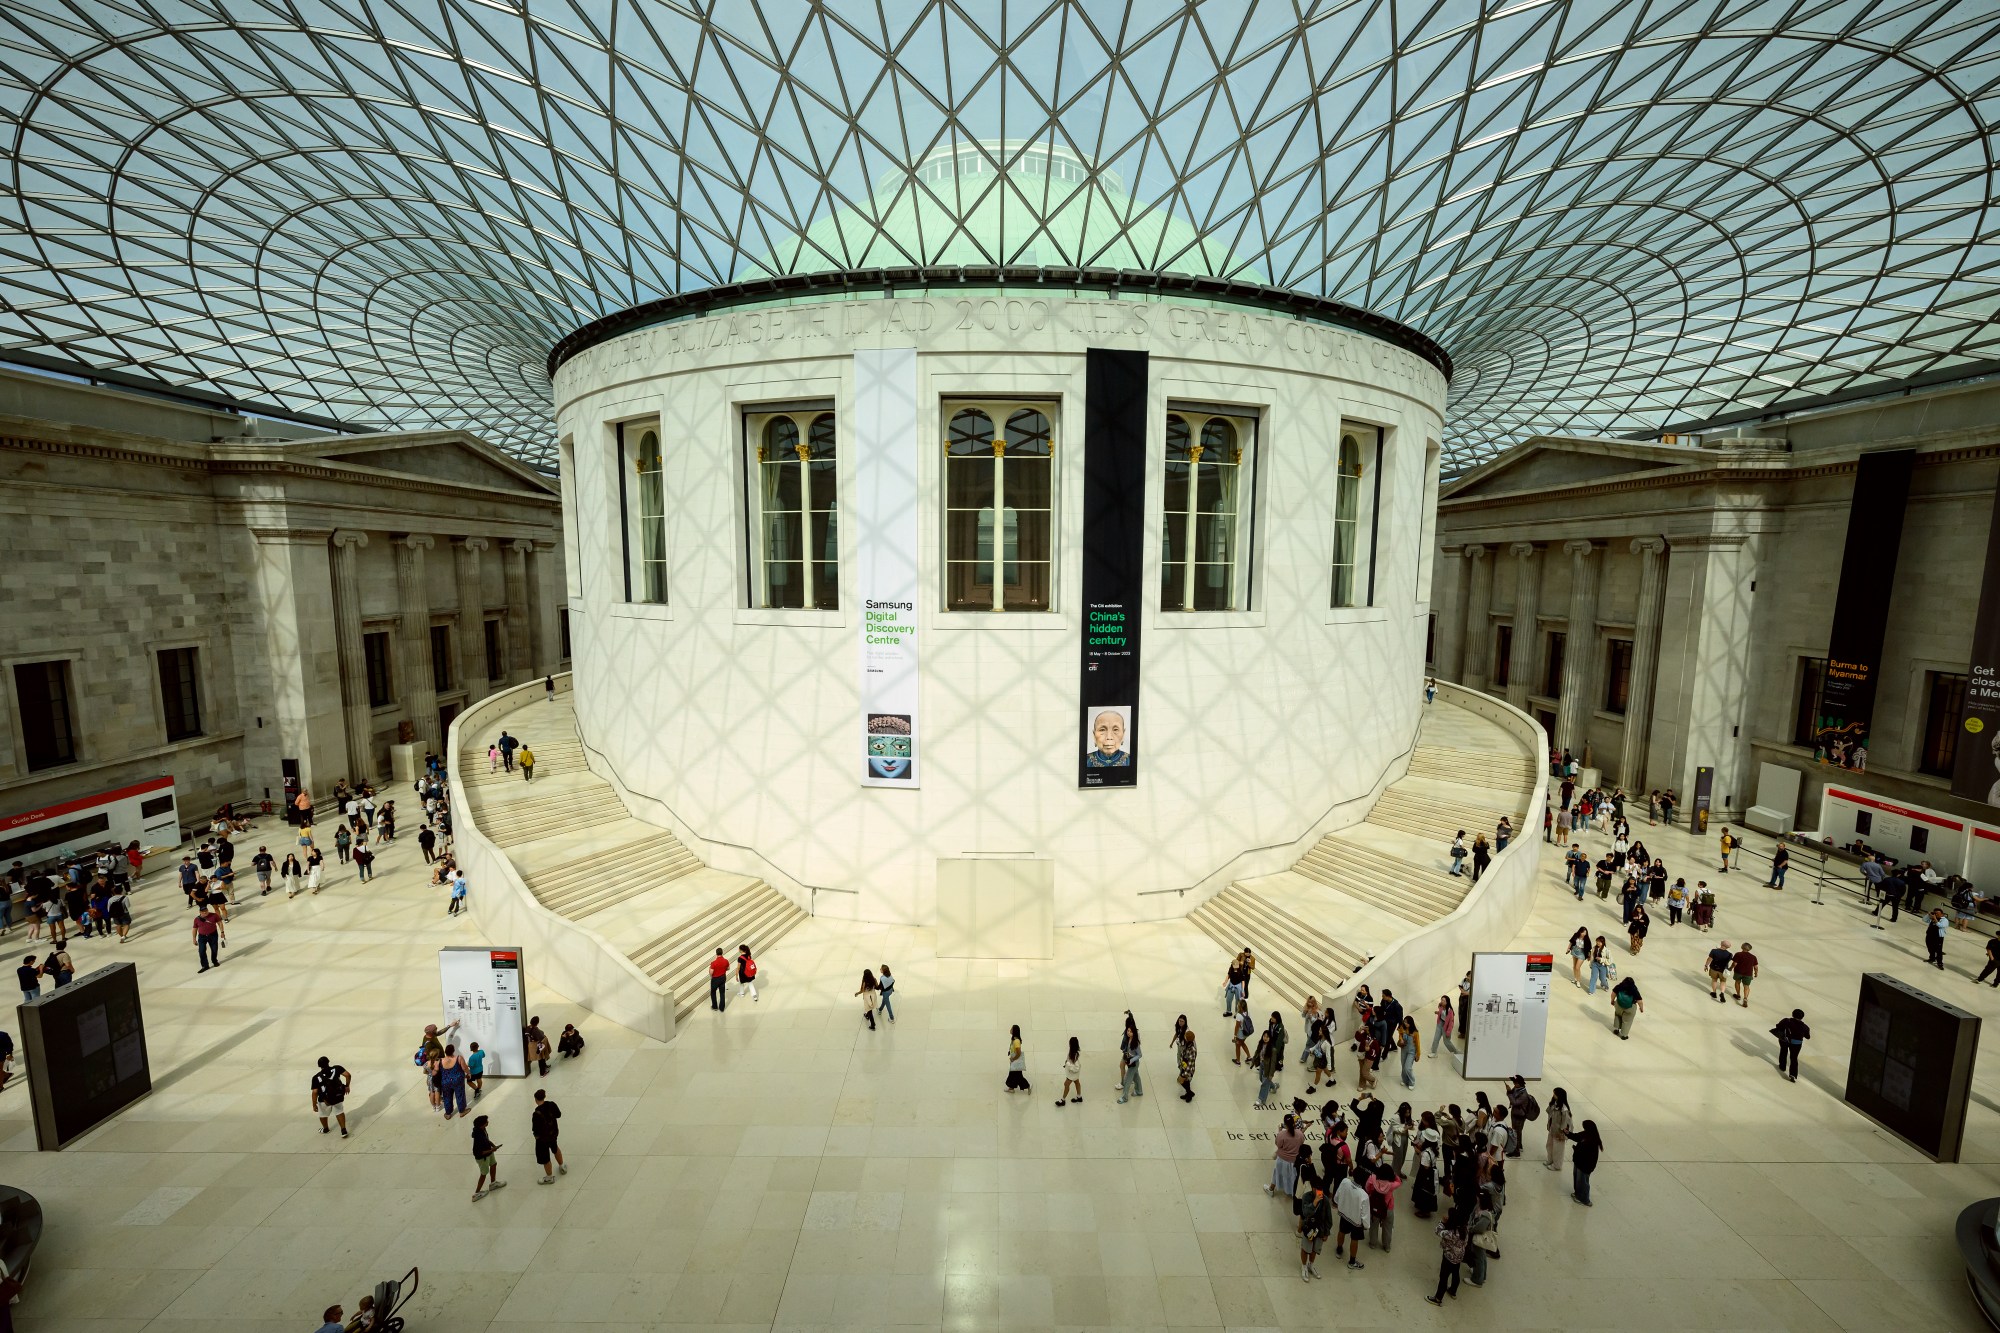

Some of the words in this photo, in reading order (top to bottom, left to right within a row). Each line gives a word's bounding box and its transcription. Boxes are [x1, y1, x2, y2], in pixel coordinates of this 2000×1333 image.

[596, 330, 658, 374] QUEEN
[667, 306, 832, 355] ELIZABETH
[844, 303, 869, 335] II
[882, 301, 937, 333] AD
[955, 300, 1049, 331] 2000
[1065, 301, 1149, 335] THIS
[1166, 307, 1273, 348] GREAT
[1285, 322, 1363, 366] COURT
[865, 599, 913, 611] Samsung
[866, 611, 897, 623] Digital
[1089, 611, 1126, 622] China's
[866, 623, 915, 635] Discovery
[1089, 623, 1123, 633] hidden
[866, 634, 901, 645] Centre
[1089, 635, 1127, 647] century
[1830, 659, 1858, 671] Burma
[1859, 663, 1869, 672] to
[1973, 665, 1995, 676] Get
[1828, 668, 1868, 681] Myanmar
[1969, 687, 1977, 696] a
[1878, 803, 1908, 815] Membership
[11, 817, 30, 825] Guide
[30, 812, 45, 820] Desk
[1253, 1102, 1277, 1110] and
[1227, 1131, 1245, 1140] be
[1249, 1131, 1270, 1140] set
